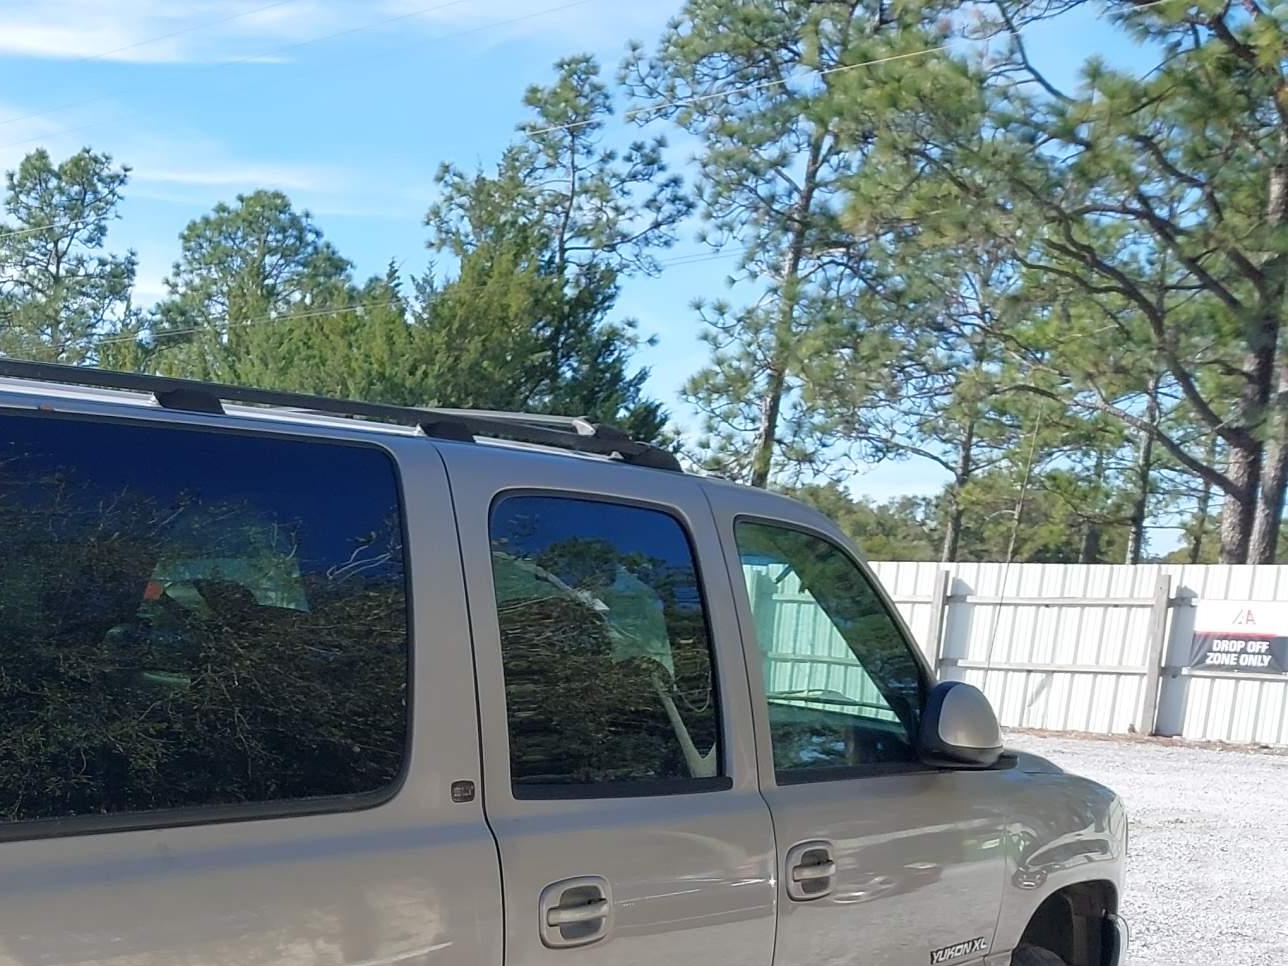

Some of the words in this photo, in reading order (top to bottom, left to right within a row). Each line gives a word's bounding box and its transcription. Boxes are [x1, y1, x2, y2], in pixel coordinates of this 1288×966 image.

[1212, 639, 1246, 653] DROP
[1246, 641, 1270, 654] OFF
[1206, 652, 1239, 665] ZONE
[1240, 654, 1272, 667] ONLY
[930, 941, 973, 965] YUKON
[972, 937, 987, 952] XL
